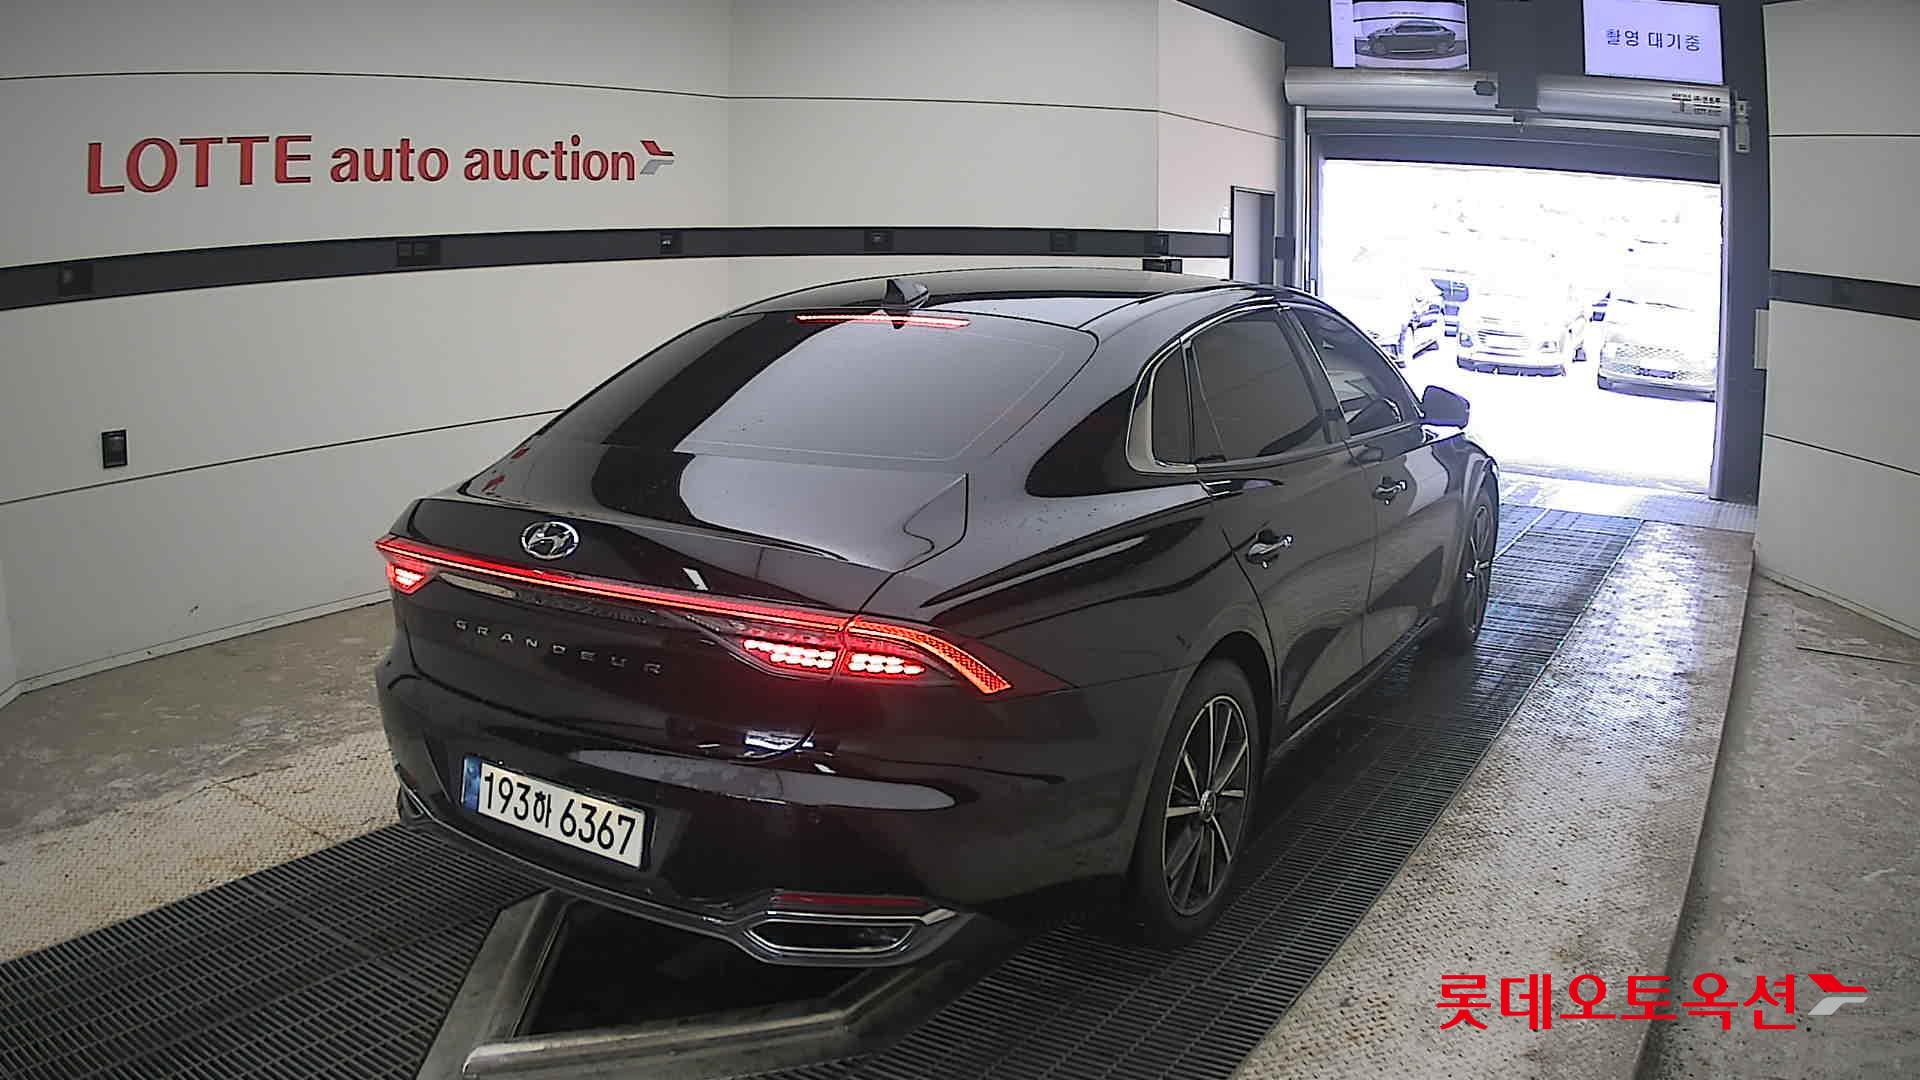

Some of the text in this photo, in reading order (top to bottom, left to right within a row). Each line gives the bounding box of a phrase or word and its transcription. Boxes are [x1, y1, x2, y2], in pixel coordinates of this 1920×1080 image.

[1647, 32, 1700, 51] 대기중
[87, 134, 635, 195] LOTTE auto auction
[455, 619, 662, 675] GRANDEUR
[484, 771, 636, 855] 193하 6367
